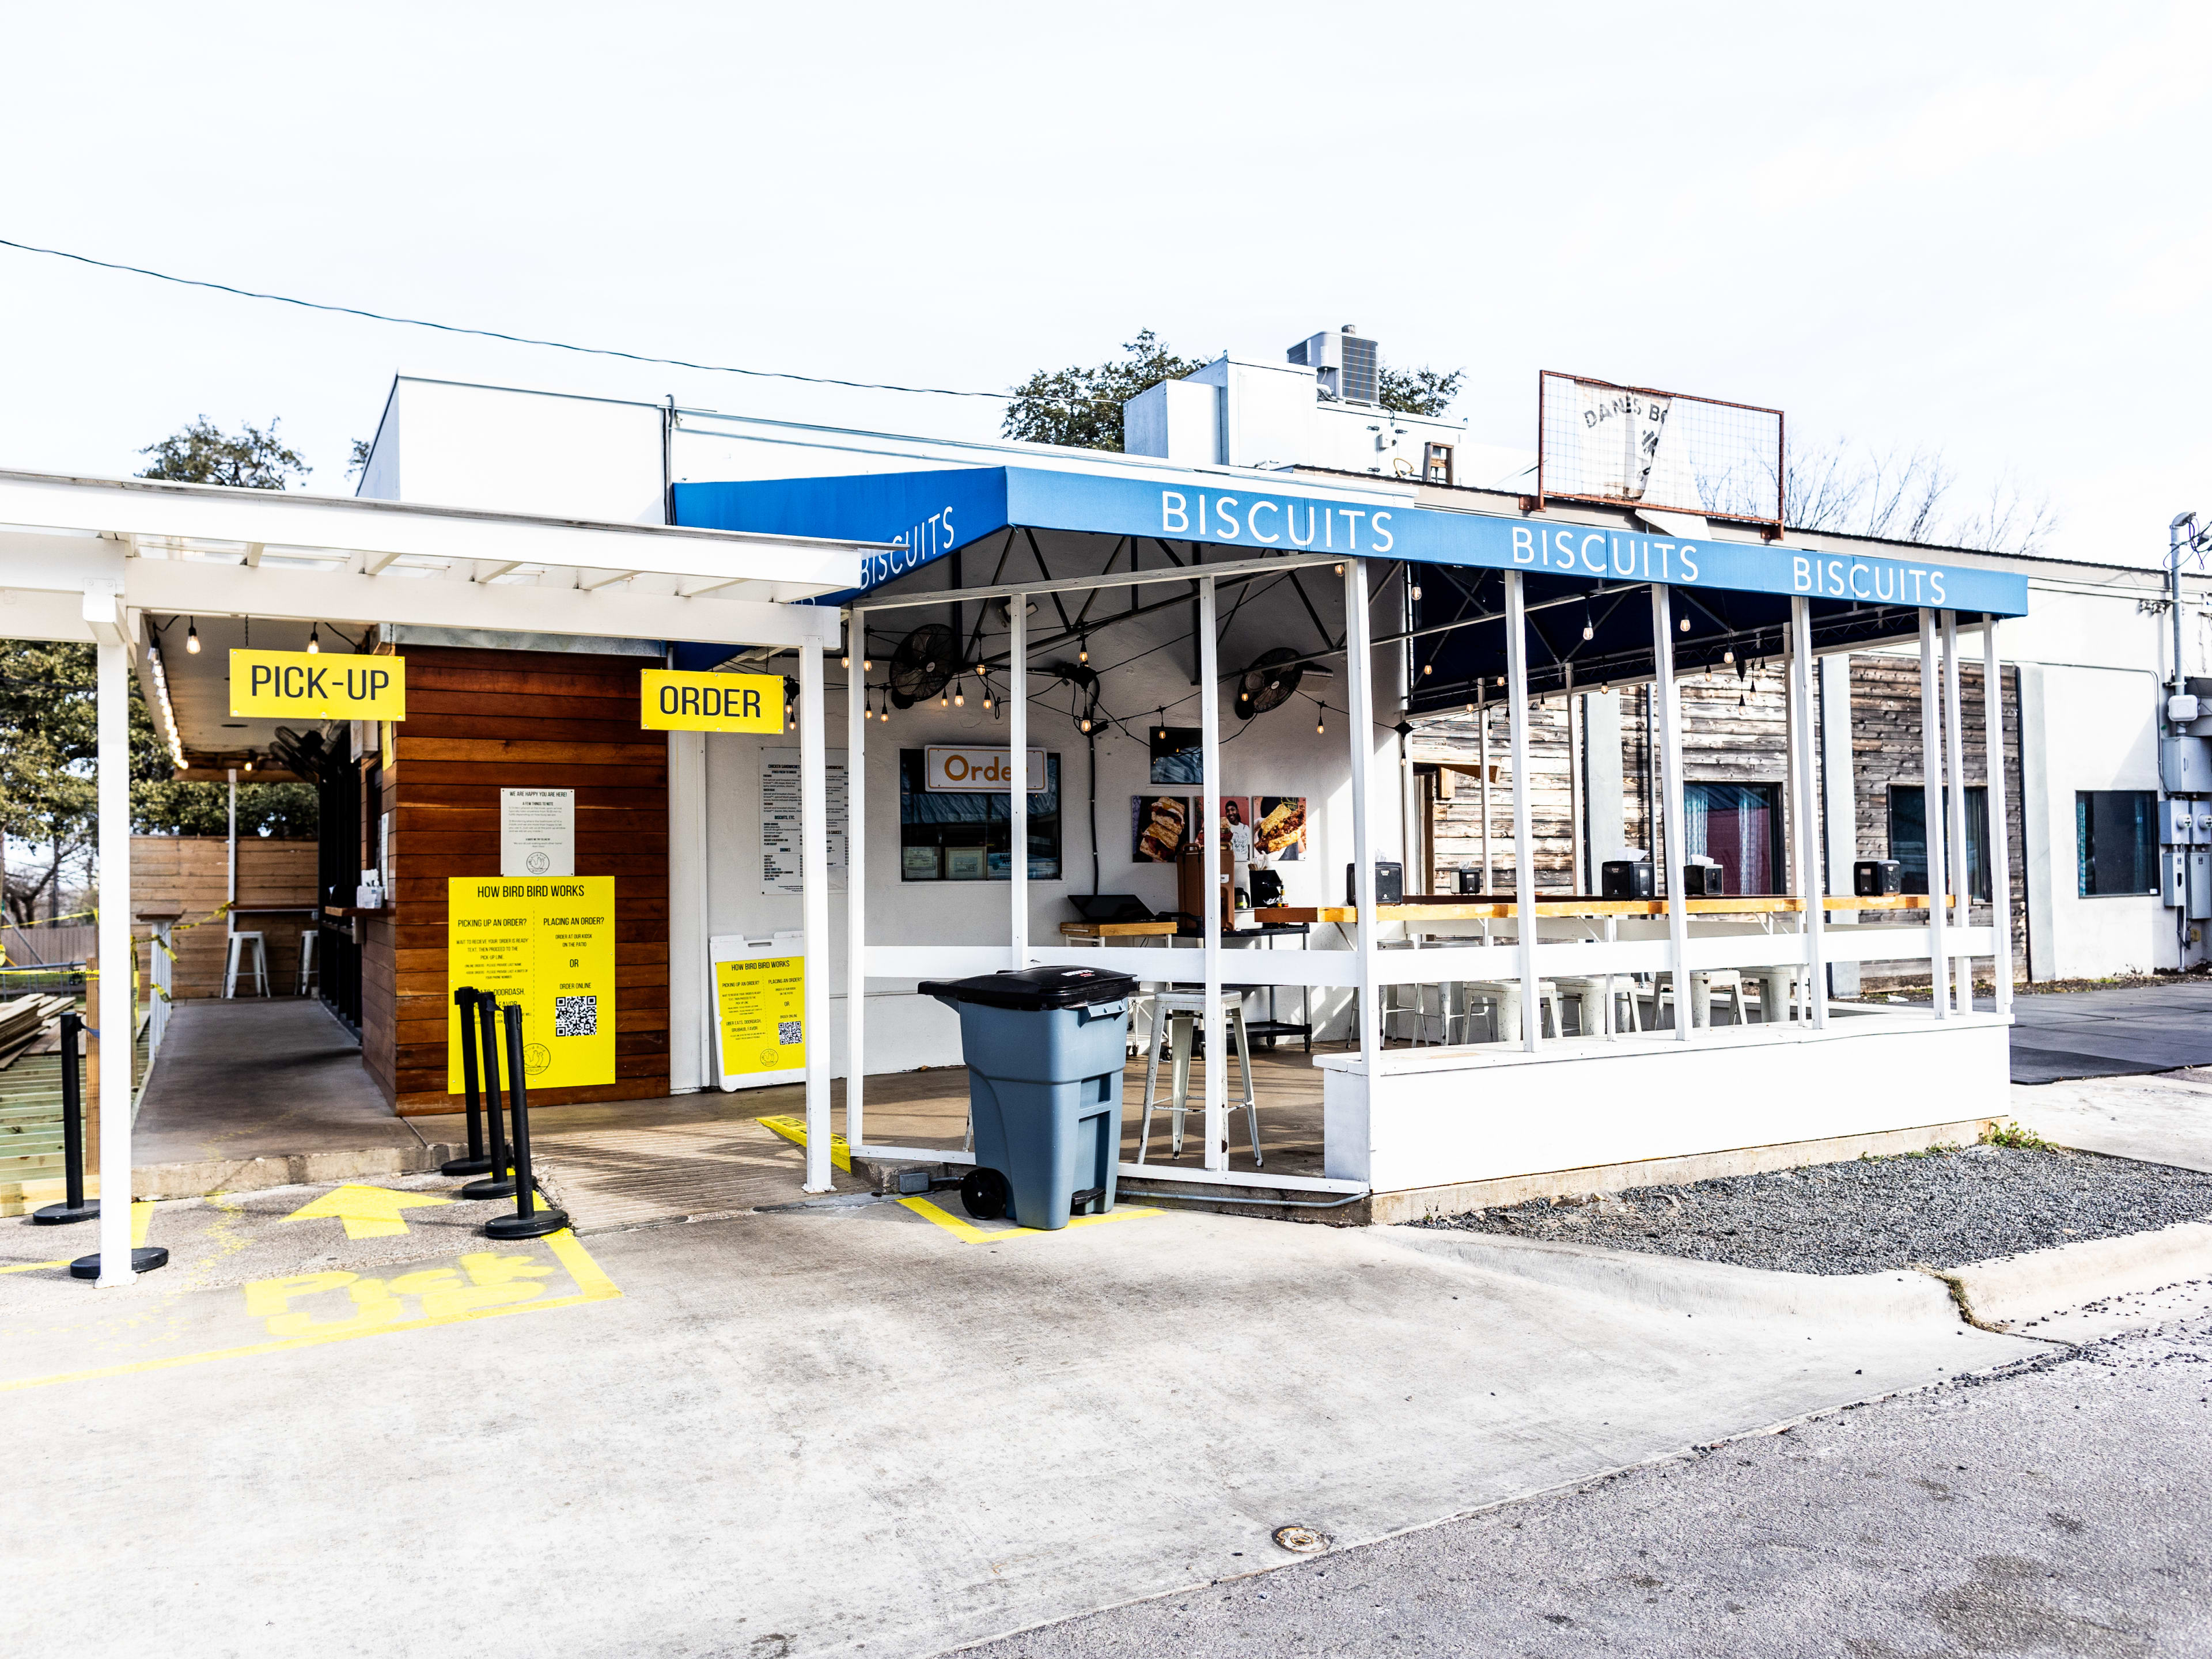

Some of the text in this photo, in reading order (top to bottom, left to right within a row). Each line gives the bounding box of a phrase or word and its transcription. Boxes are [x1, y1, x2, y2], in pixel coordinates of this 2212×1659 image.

[1162, 491, 1393, 552] BISCUITS
[861, 506, 954, 590] BISCUITS
[1512, 527, 1698, 582] BISCUITS
[1794, 556, 1946, 605] BISCUITS
[251, 665, 389, 700] PICK-UP
[660, 685, 761, 718] ORDER
[944, 755, 1028, 781] Orde
[478, 885, 585, 897] HOW BIRD BIRD WORKS
[503, 918, 527, 926] ORDER?
[543, 918, 569, 926] PLACING
[581, 917, 604, 925] ORDER?
[570, 959, 579, 968] OR
[771, 960, 790, 968] WORKS
